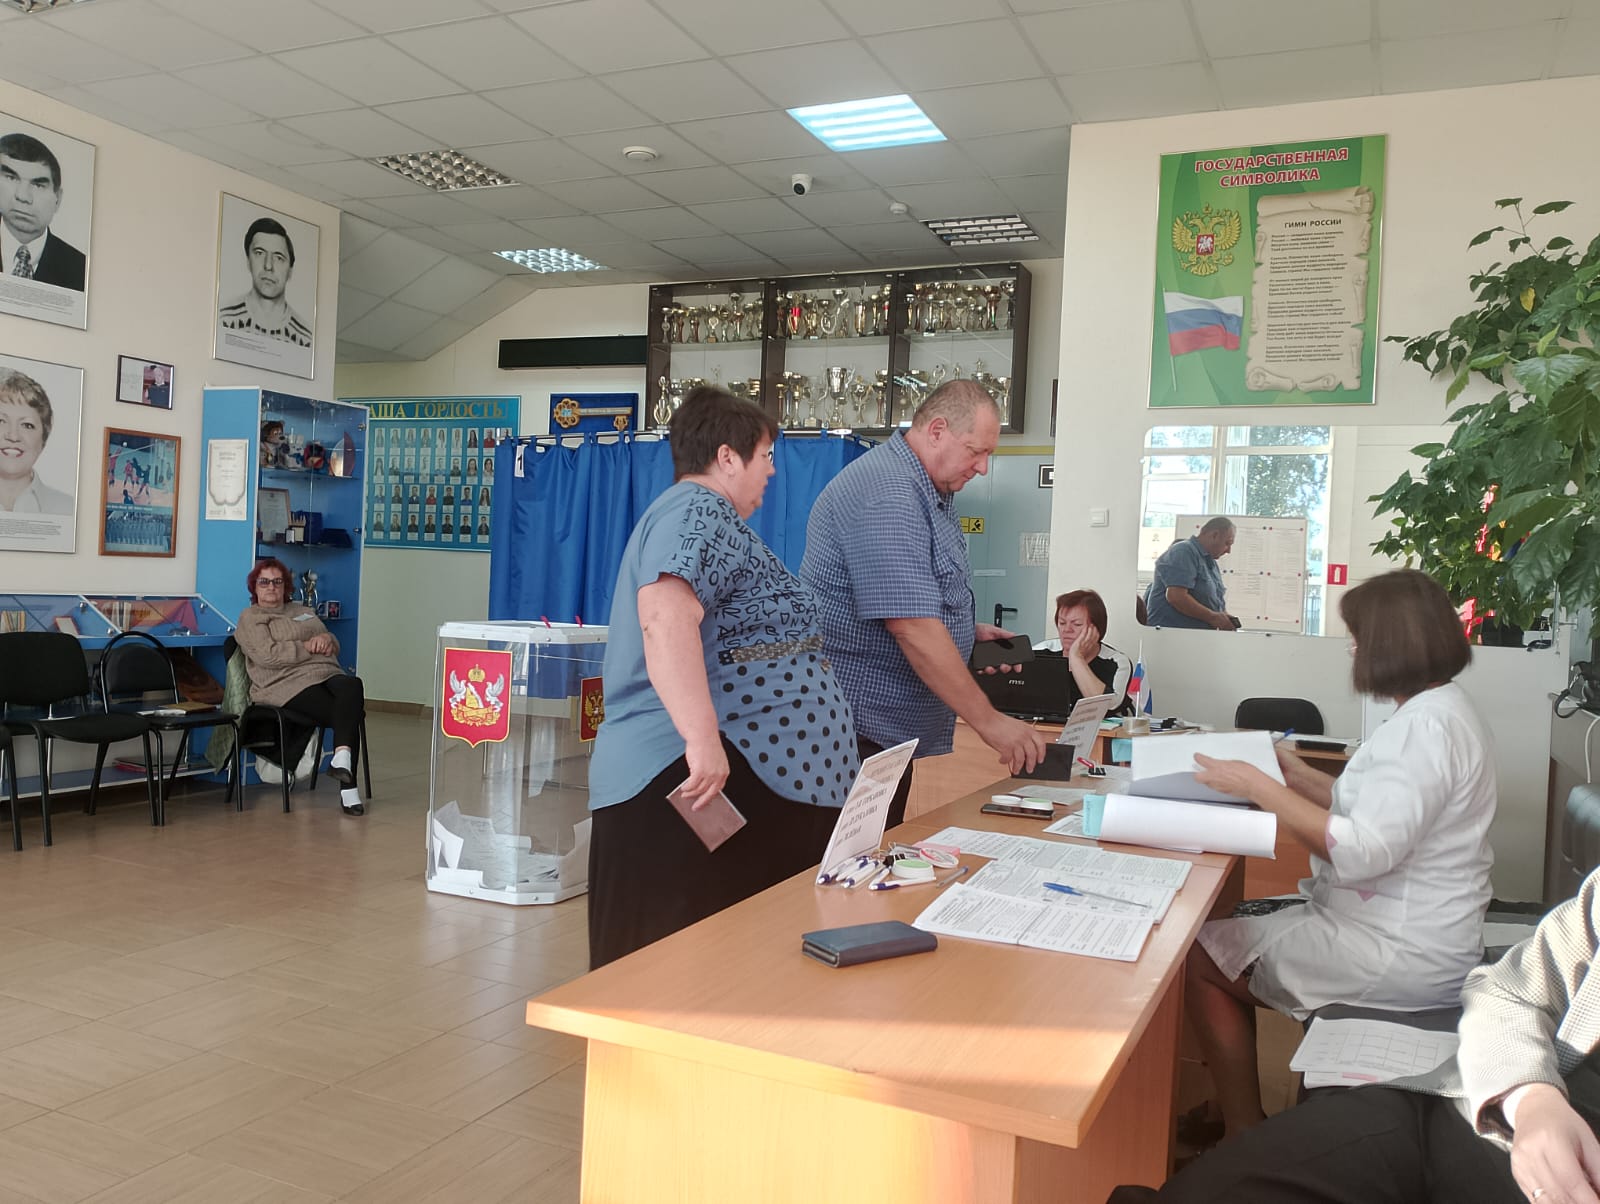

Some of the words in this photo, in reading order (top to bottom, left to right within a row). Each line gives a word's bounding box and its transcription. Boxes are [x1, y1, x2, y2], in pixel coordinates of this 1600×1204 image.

[1195, 148, 1349, 172] ГОСУДАРСТВЕННАЯ
[1219, 168, 1320, 187] СИМВОЛИКА
[1284, 221, 1307, 229] ГИМН
[1309, 218, 1342, 228] РОССИИ
[369, 402, 407, 418] АША
[413, 400, 503, 419] ГОРДОСТЬ
